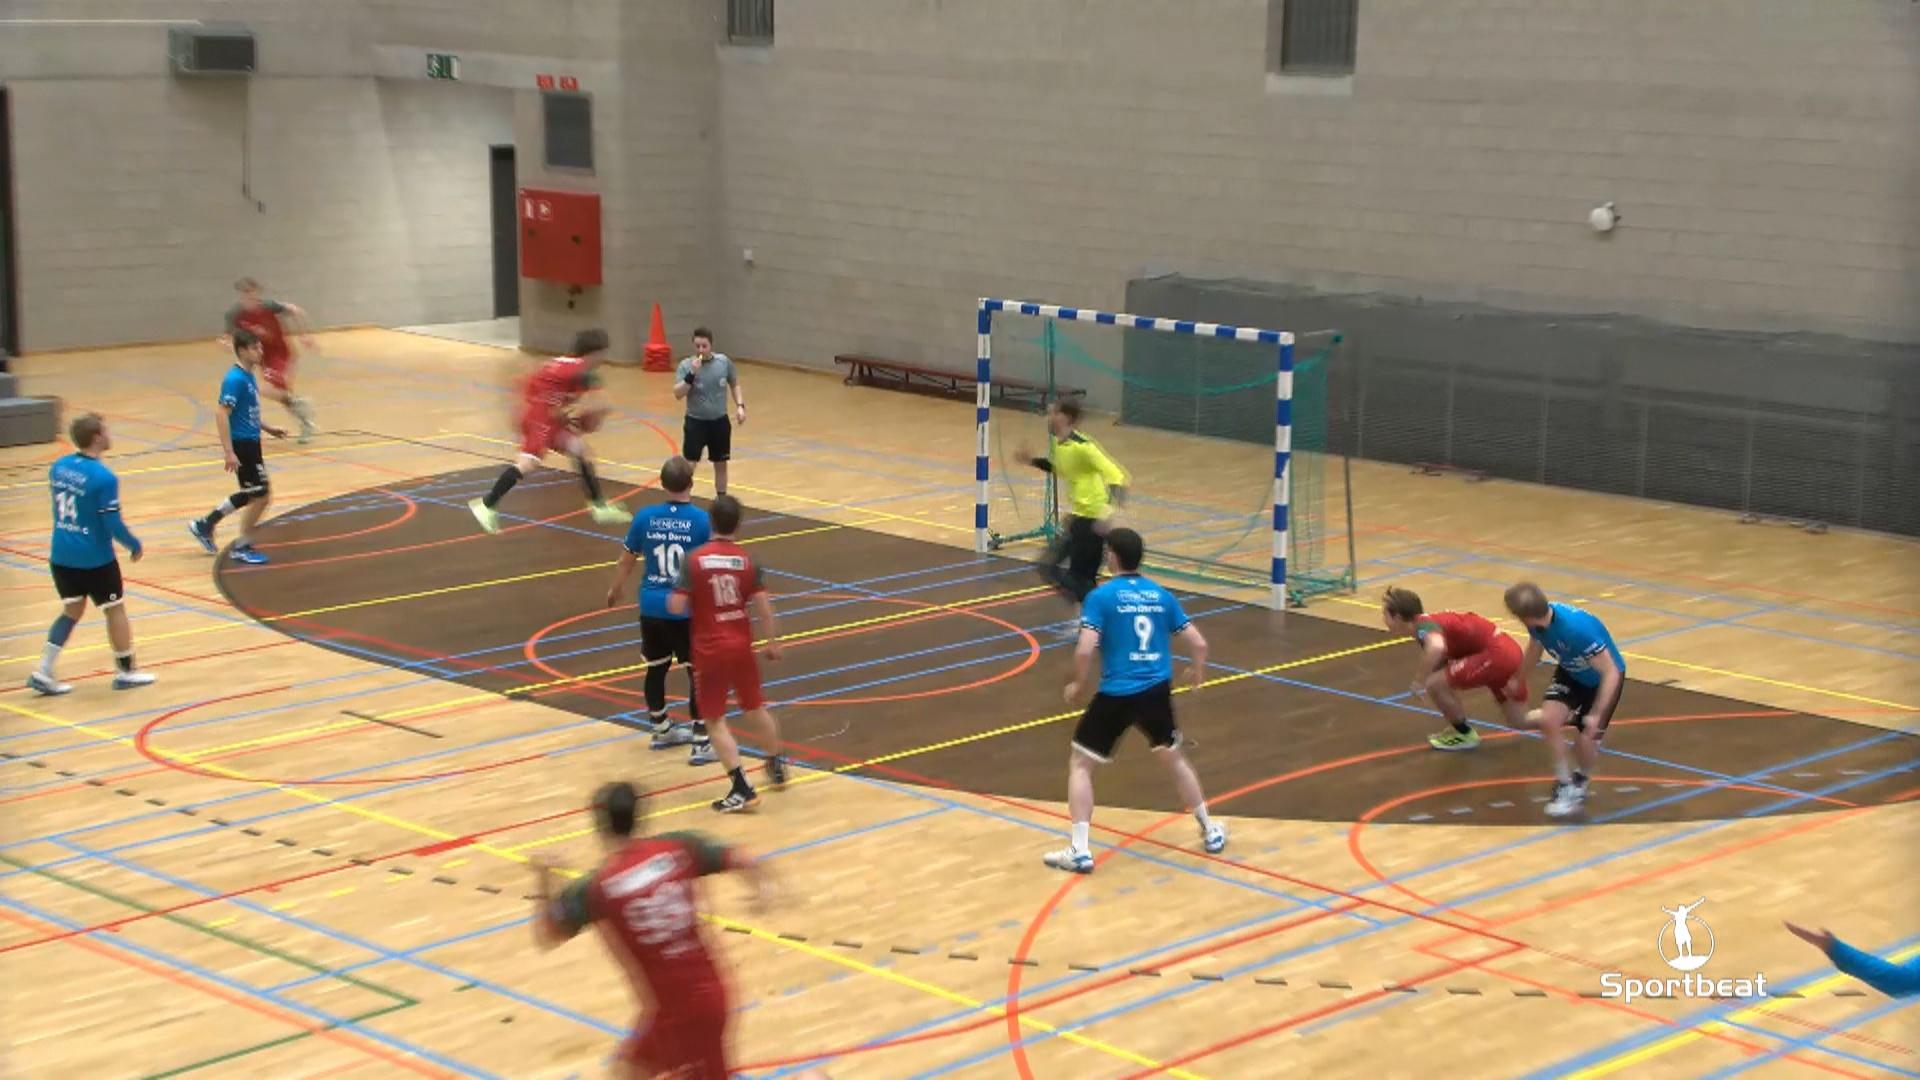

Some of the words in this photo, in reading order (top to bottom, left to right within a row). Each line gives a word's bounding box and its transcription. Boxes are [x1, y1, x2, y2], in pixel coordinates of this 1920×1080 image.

[55, 491, 78, 523] 14
[653, 543, 685, 577] 10
[1133, 615, 1154, 651] 9
